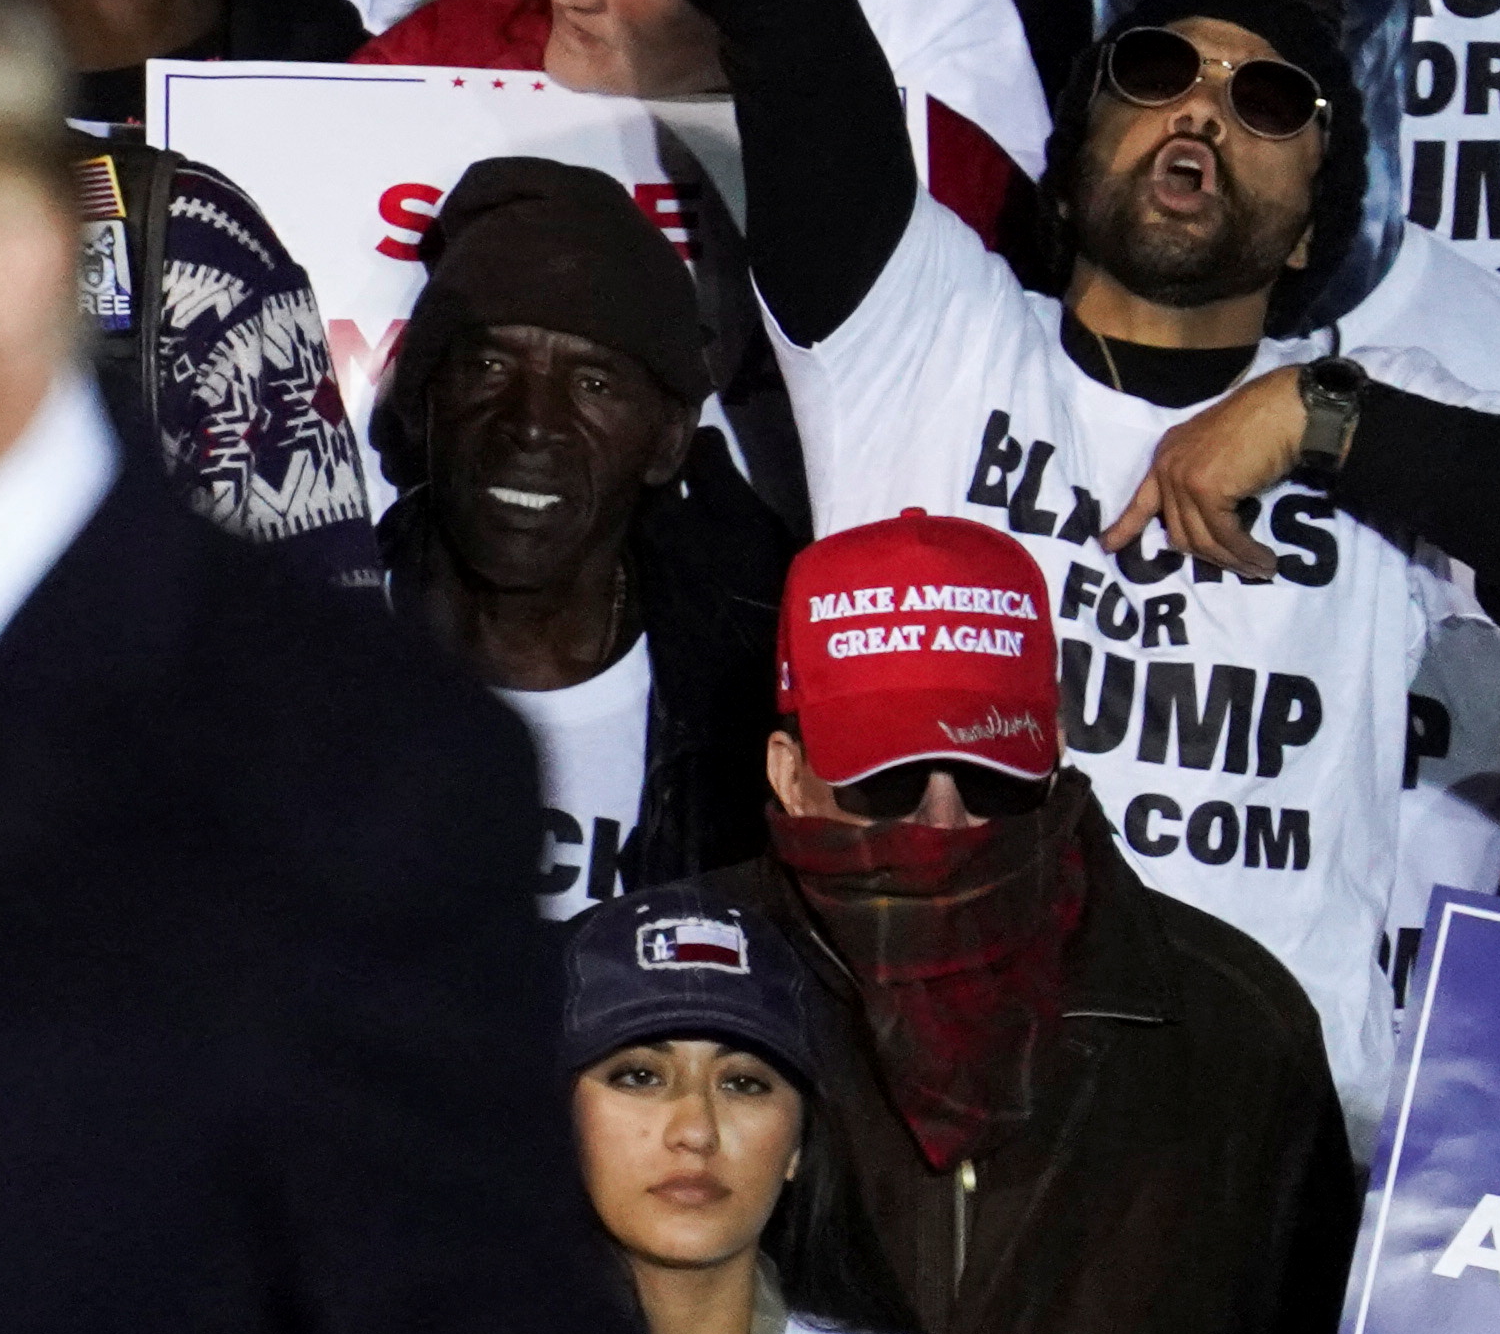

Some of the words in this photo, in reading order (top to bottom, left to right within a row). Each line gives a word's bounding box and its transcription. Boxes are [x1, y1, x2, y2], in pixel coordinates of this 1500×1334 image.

[810, 589, 895, 622] MAKE
[900, 585, 1038, 620] AMERICA
[1059, 564, 1189, 648] FOR
[827, 625, 927, 659] GREAT
[932, 620, 1024, 657] AGAIN
[1056, 641, 1323, 779] UMP
